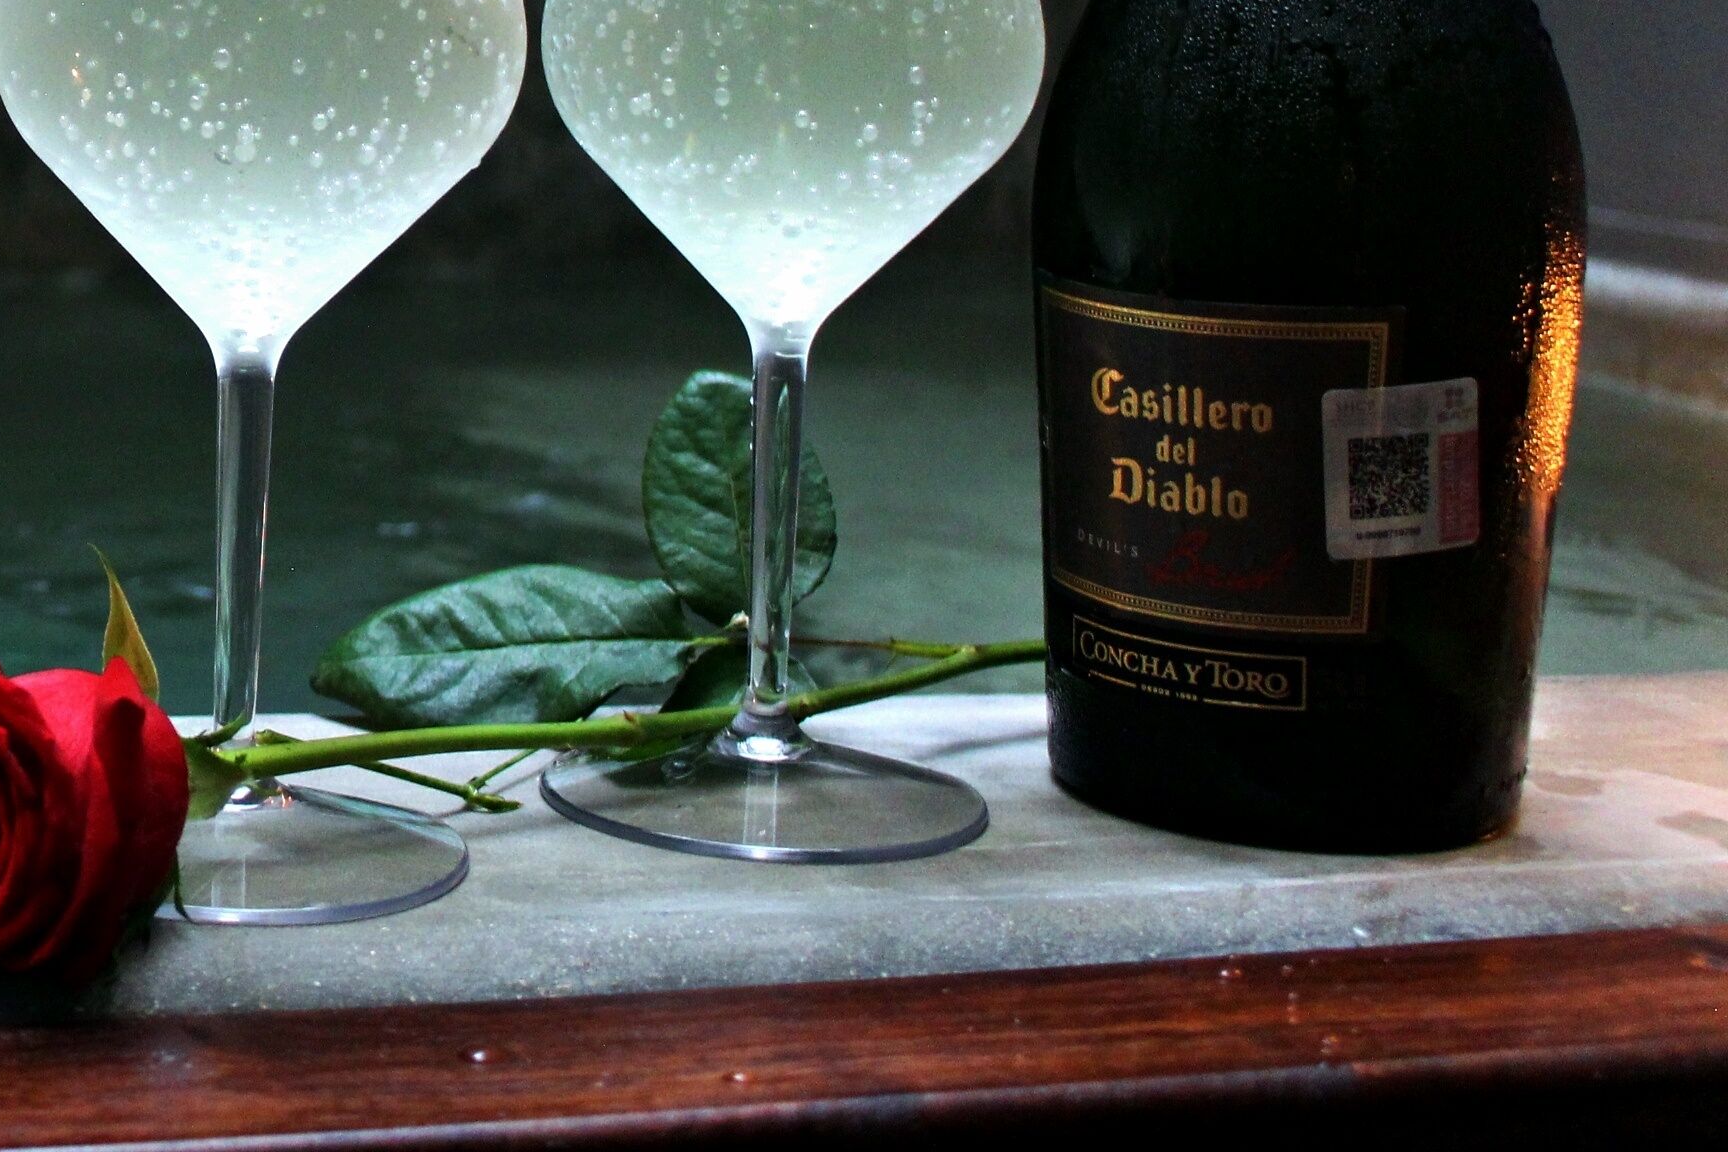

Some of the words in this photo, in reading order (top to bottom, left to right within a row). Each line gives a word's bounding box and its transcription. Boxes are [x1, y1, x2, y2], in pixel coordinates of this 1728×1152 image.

[1090, 366, 1275, 435] Casillero
[1154, 433, 1199, 467] del
[1108, 454, 1251, 521] Diablo
[1076, 527, 1139, 558] DEVIL'S
[1079, 630, 1179, 682] CONCHA
[1183, 661, 1203, 684] Y
[1203, 658, 1293, 700] TORO
